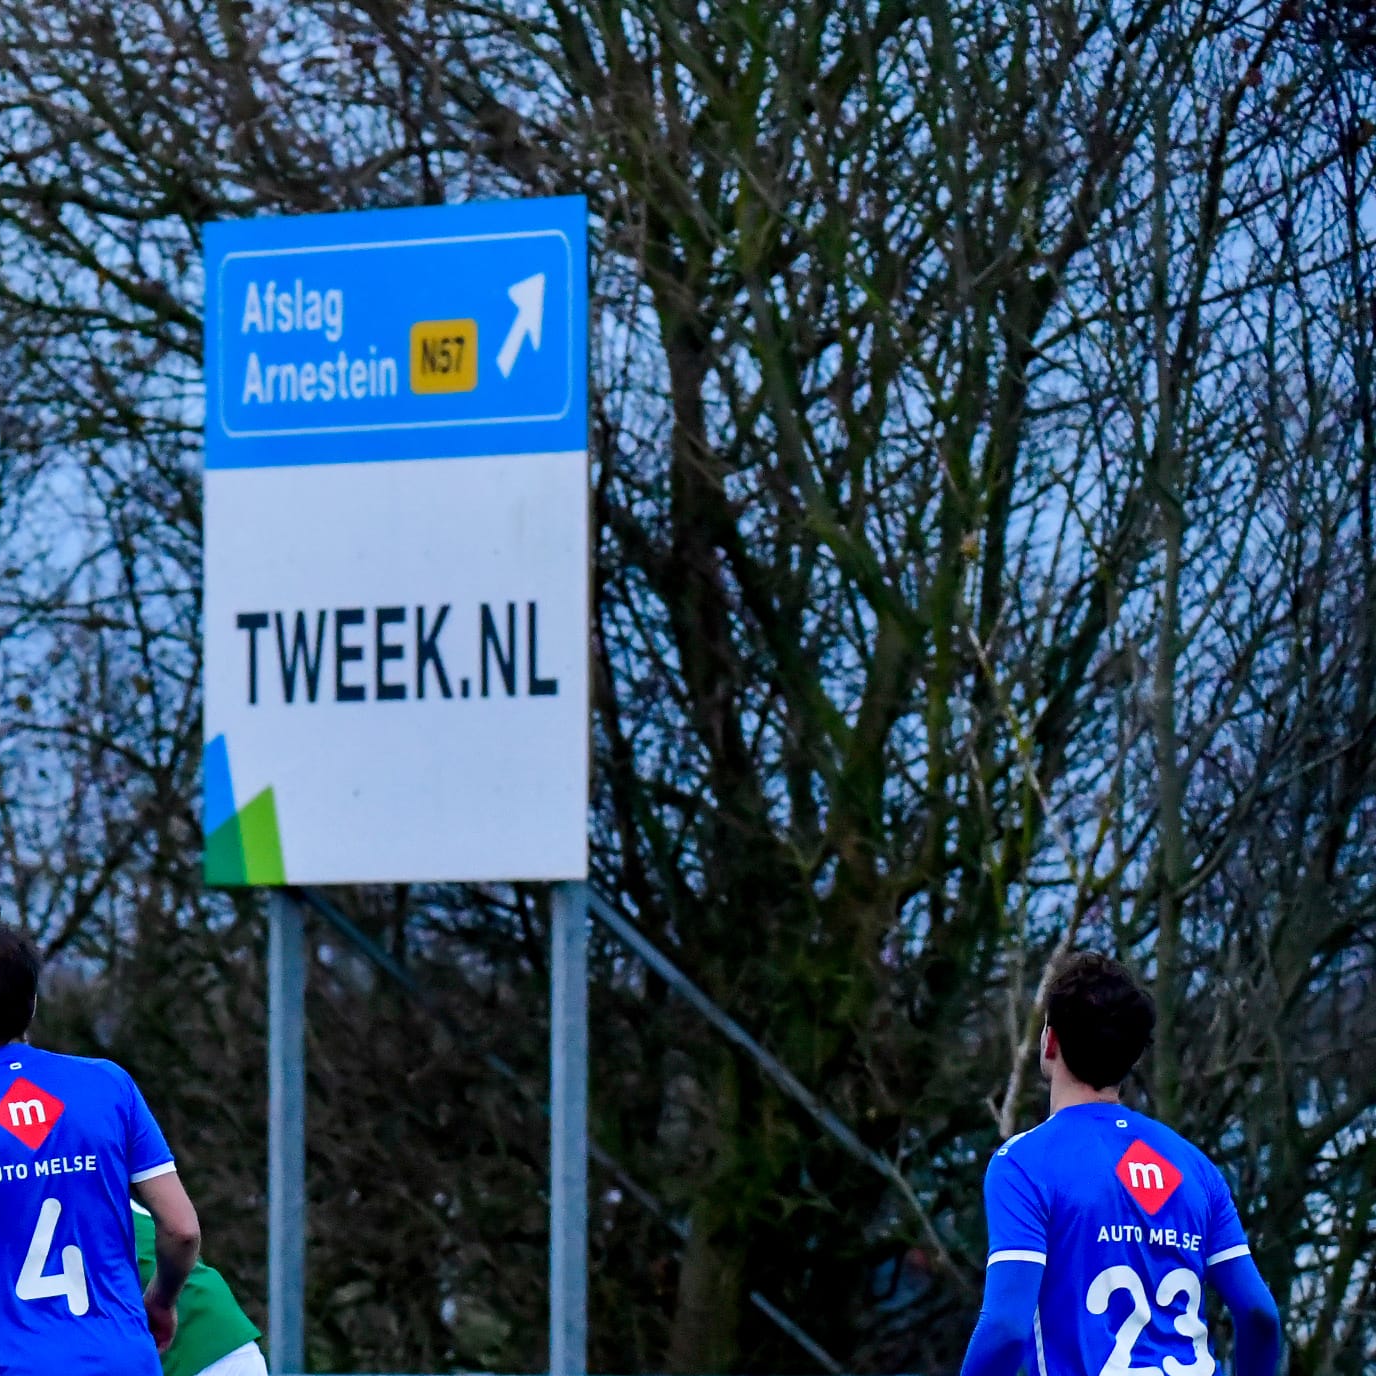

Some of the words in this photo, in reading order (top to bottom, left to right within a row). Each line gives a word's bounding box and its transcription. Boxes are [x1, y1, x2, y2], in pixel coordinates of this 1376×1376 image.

[241, 278, 344, 342] Afslag
[242, 345, 398, 405] Arnestein
[421, 336, 465, 376] N57
[236, 601, 558, 704] TWEEK.NL
[34, 1155, 98, 1178] MELSE
[15, 1197, 89, 1317] 4
[1097, 1225, 1143, 1243] AUTO
[1149, 1228, 1202, 1252] MELSE
